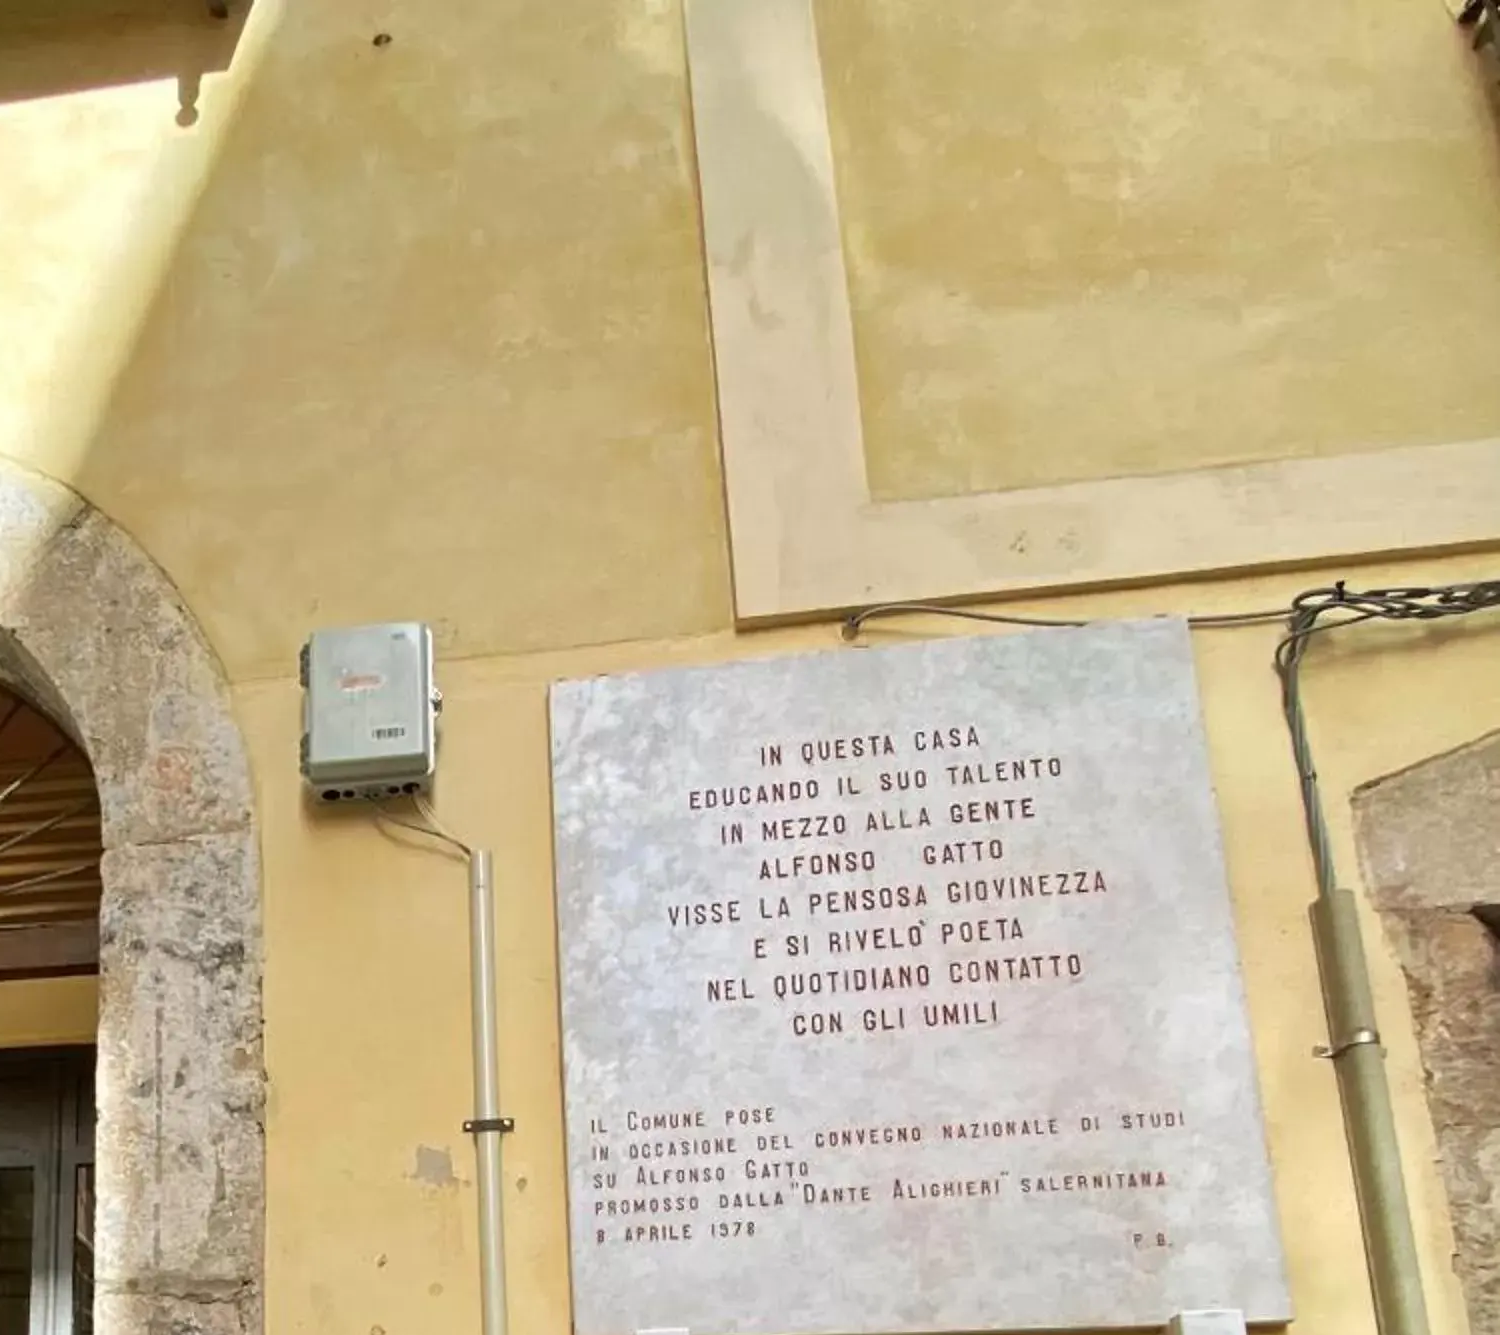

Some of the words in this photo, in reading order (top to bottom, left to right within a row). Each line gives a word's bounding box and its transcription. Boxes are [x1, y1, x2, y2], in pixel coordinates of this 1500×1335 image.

[760, 744, 783, 767] IN
[801, 735, 895, 765] QUESTA
[914, 726, 980, 752] CASA
[689, 779, 820, 810] EDUCANDO
[837, 776, 861, 797] IL
[880, 769, 928, 791] SUO
[946, 757, 1062, 786] TALENTO
[720, 822, 743, 845] IN
[762, 815, 847, 841] MEZZO
[866, 807, 932, 832] ALLA
[950, 798, 1036, 824] GENTE
[759, 851, 876, 880] ALFONSO
[923, 839, 1004, 866] GATTO
[667, 901, 741, 926] VISSE
[759, 896, 791, 919] LA
[808, 885, 928, 915] PENSOSA
[947, 871, 1107, 904] GIOVINEZZA
[753, 937, 768, 959] E
[786, 935, 809, 957] SI
[941, 917, 1024, 944] POETA
[706, 978, 755, 1002] NEL
[773, 964, 930, 999] QUOTIDIANO
[949, 953, 1081, 984] CONTATTO
[792, 1012, 844, 1037] CON
[863, 1006, 905, 1031] GLI
[923, 1000, 998, 1027] UMILI
[590, 1118, 608, 1134] IL
[725, 1107, 775, 1126] POSE
[592, 1145, 609, 1161] IN
[628, 1137, 738, 1160] OCCASIONE
[756, 1135, 794, 1151] DEL
[815, 1127, 921, 1148] CONVEGNO
[942, 1118, 1060, 1140] NAZIONALE
[1081, 1116, 1100, 1132] DI
[1121, 1111, 1185, 1130] STUDI
[592, 1172, 617, 1190] SU
[594, 1196, 700, 1216] PROMOSSO
[718, 1190, 785, 1209] DALLA
[1020, 1171, 1167, 1193] SALERNITANA
[624, 1223, 693, 1243] APRILE
[710, 1220, 757, 1238] 1978
